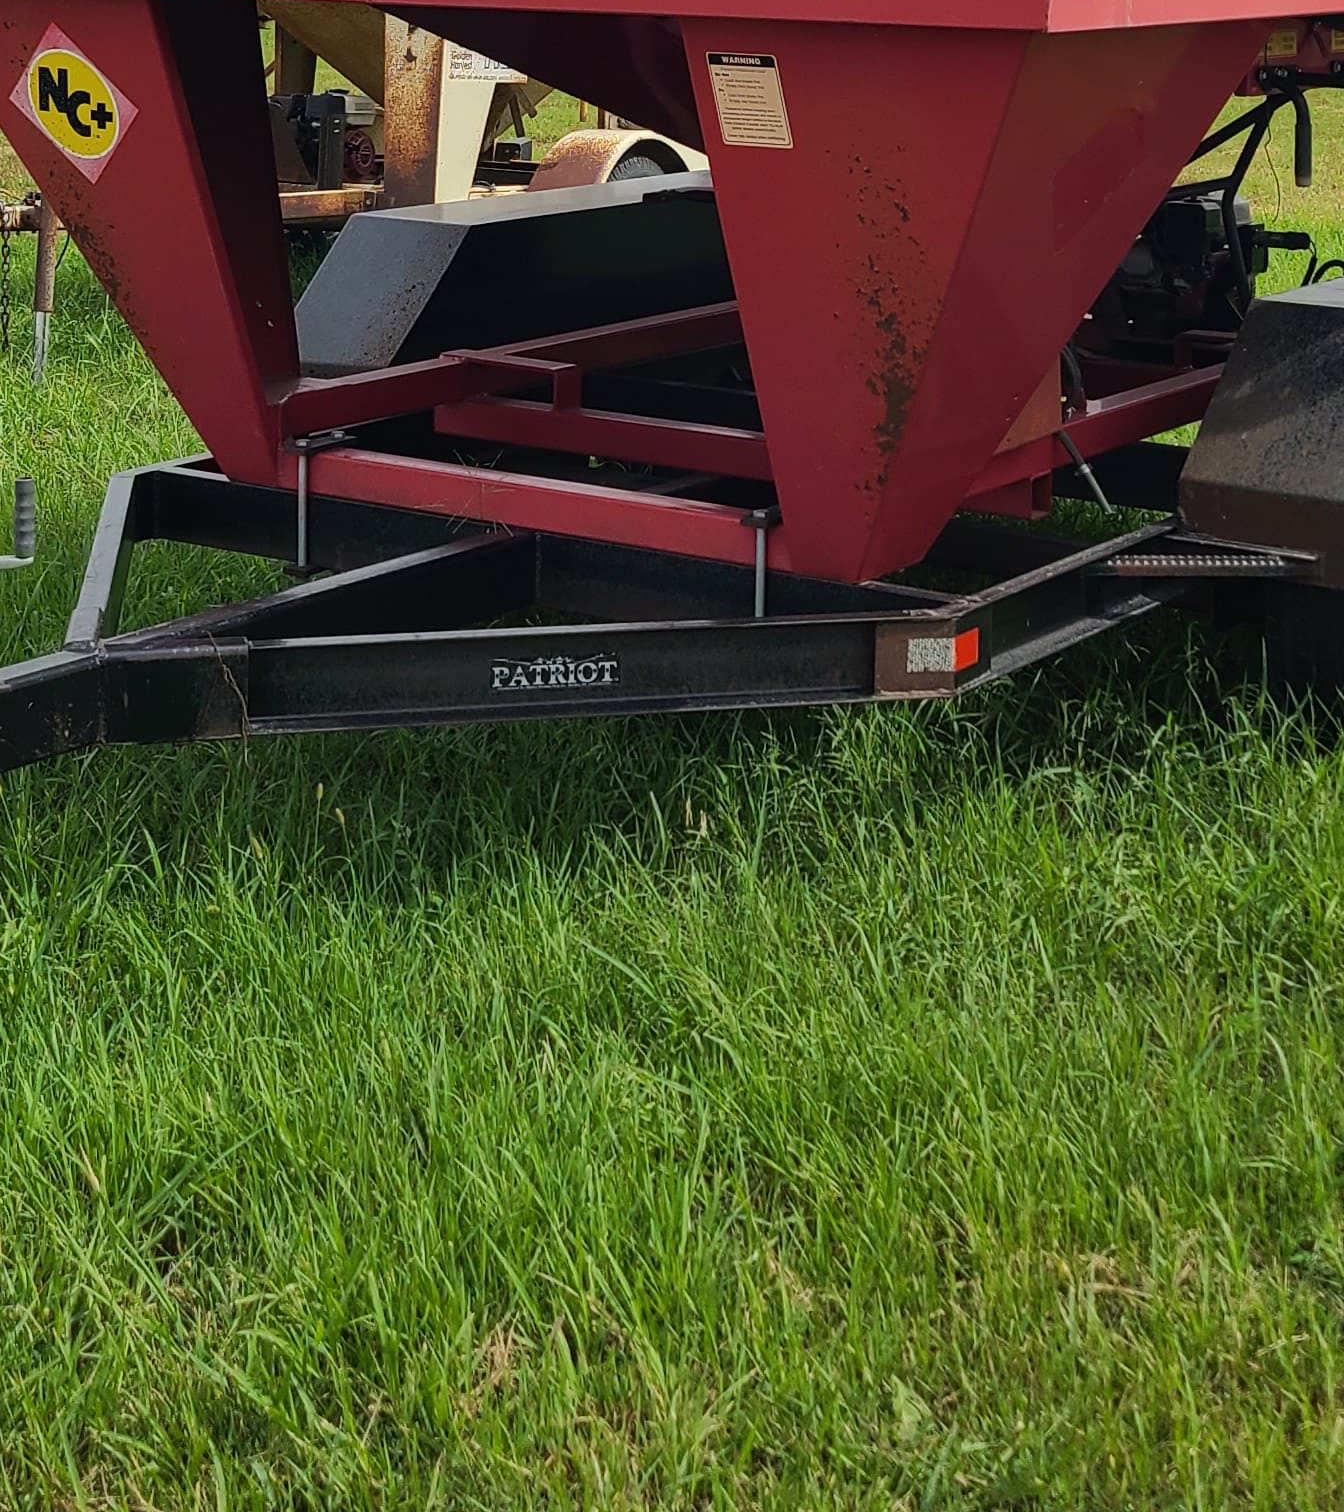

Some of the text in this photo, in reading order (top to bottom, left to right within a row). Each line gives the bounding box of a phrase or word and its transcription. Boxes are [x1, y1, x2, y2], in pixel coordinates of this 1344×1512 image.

[721, 55, 762, 66] WARNING
[38, 66, 113, 138] NC+
[492, 661, 618, 688] PATRIOT
